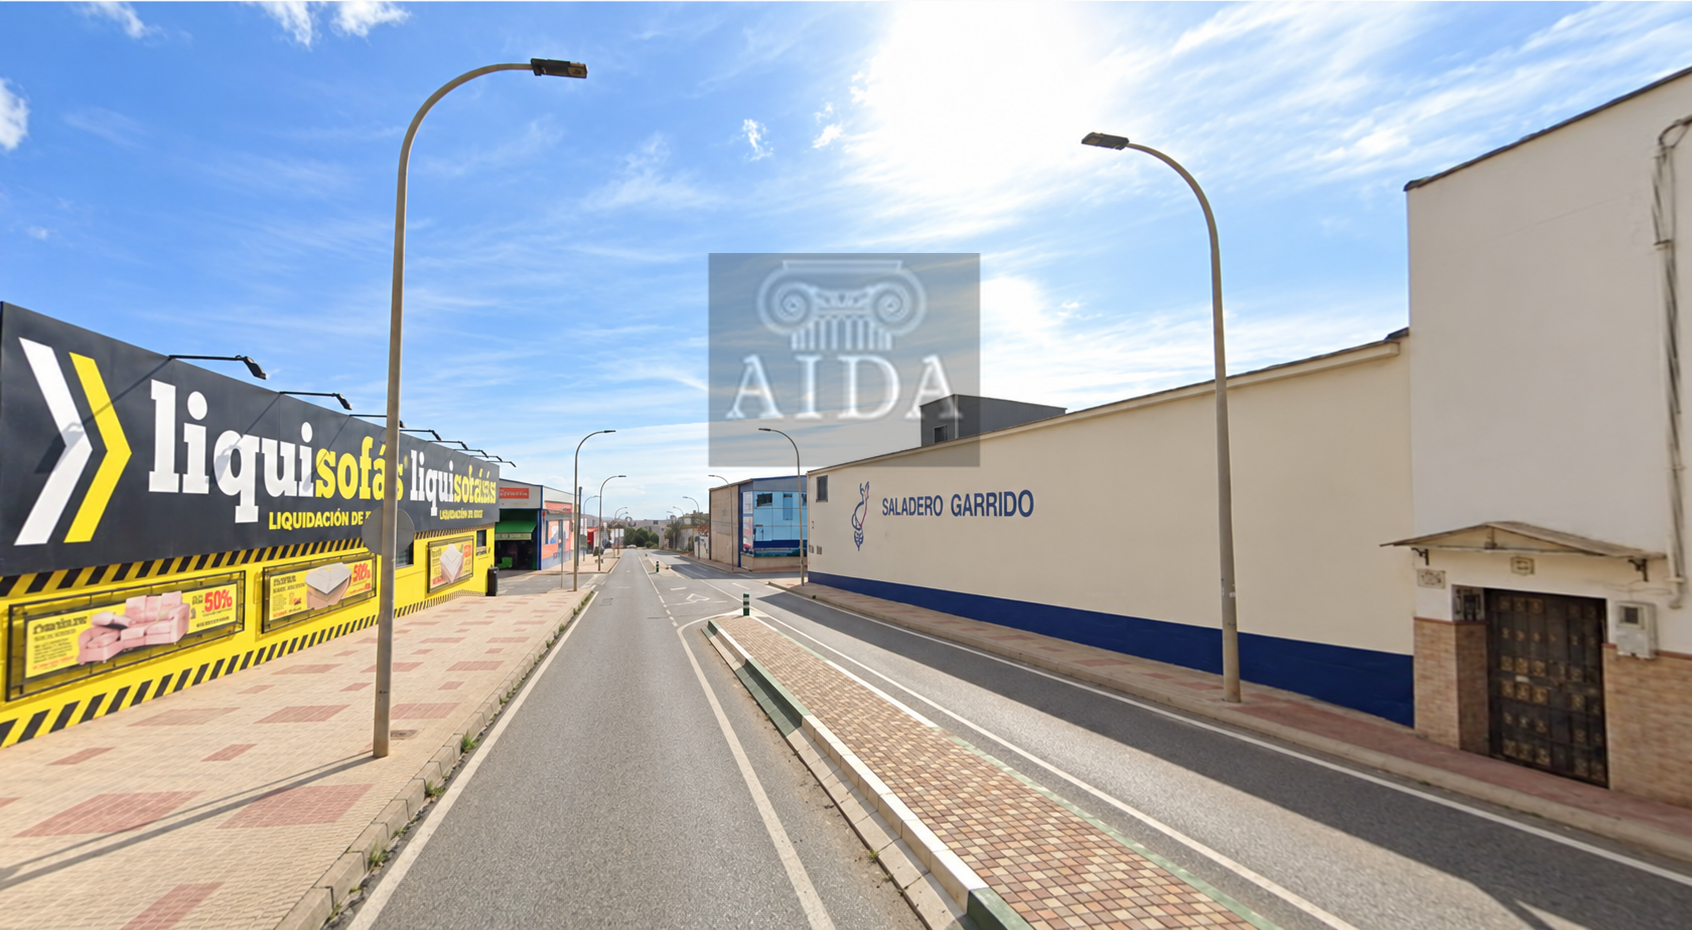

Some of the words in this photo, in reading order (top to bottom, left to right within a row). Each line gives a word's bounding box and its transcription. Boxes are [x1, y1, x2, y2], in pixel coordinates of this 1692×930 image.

[882, 495, 943, 516] SALADERO
[951, 490, 1034, 517] GARRIDO
[269, 508, 349, 531] LIQUIDACIÓN
[351, 511, 364, 526] DE
[204, 589, 233, 612] 50%
